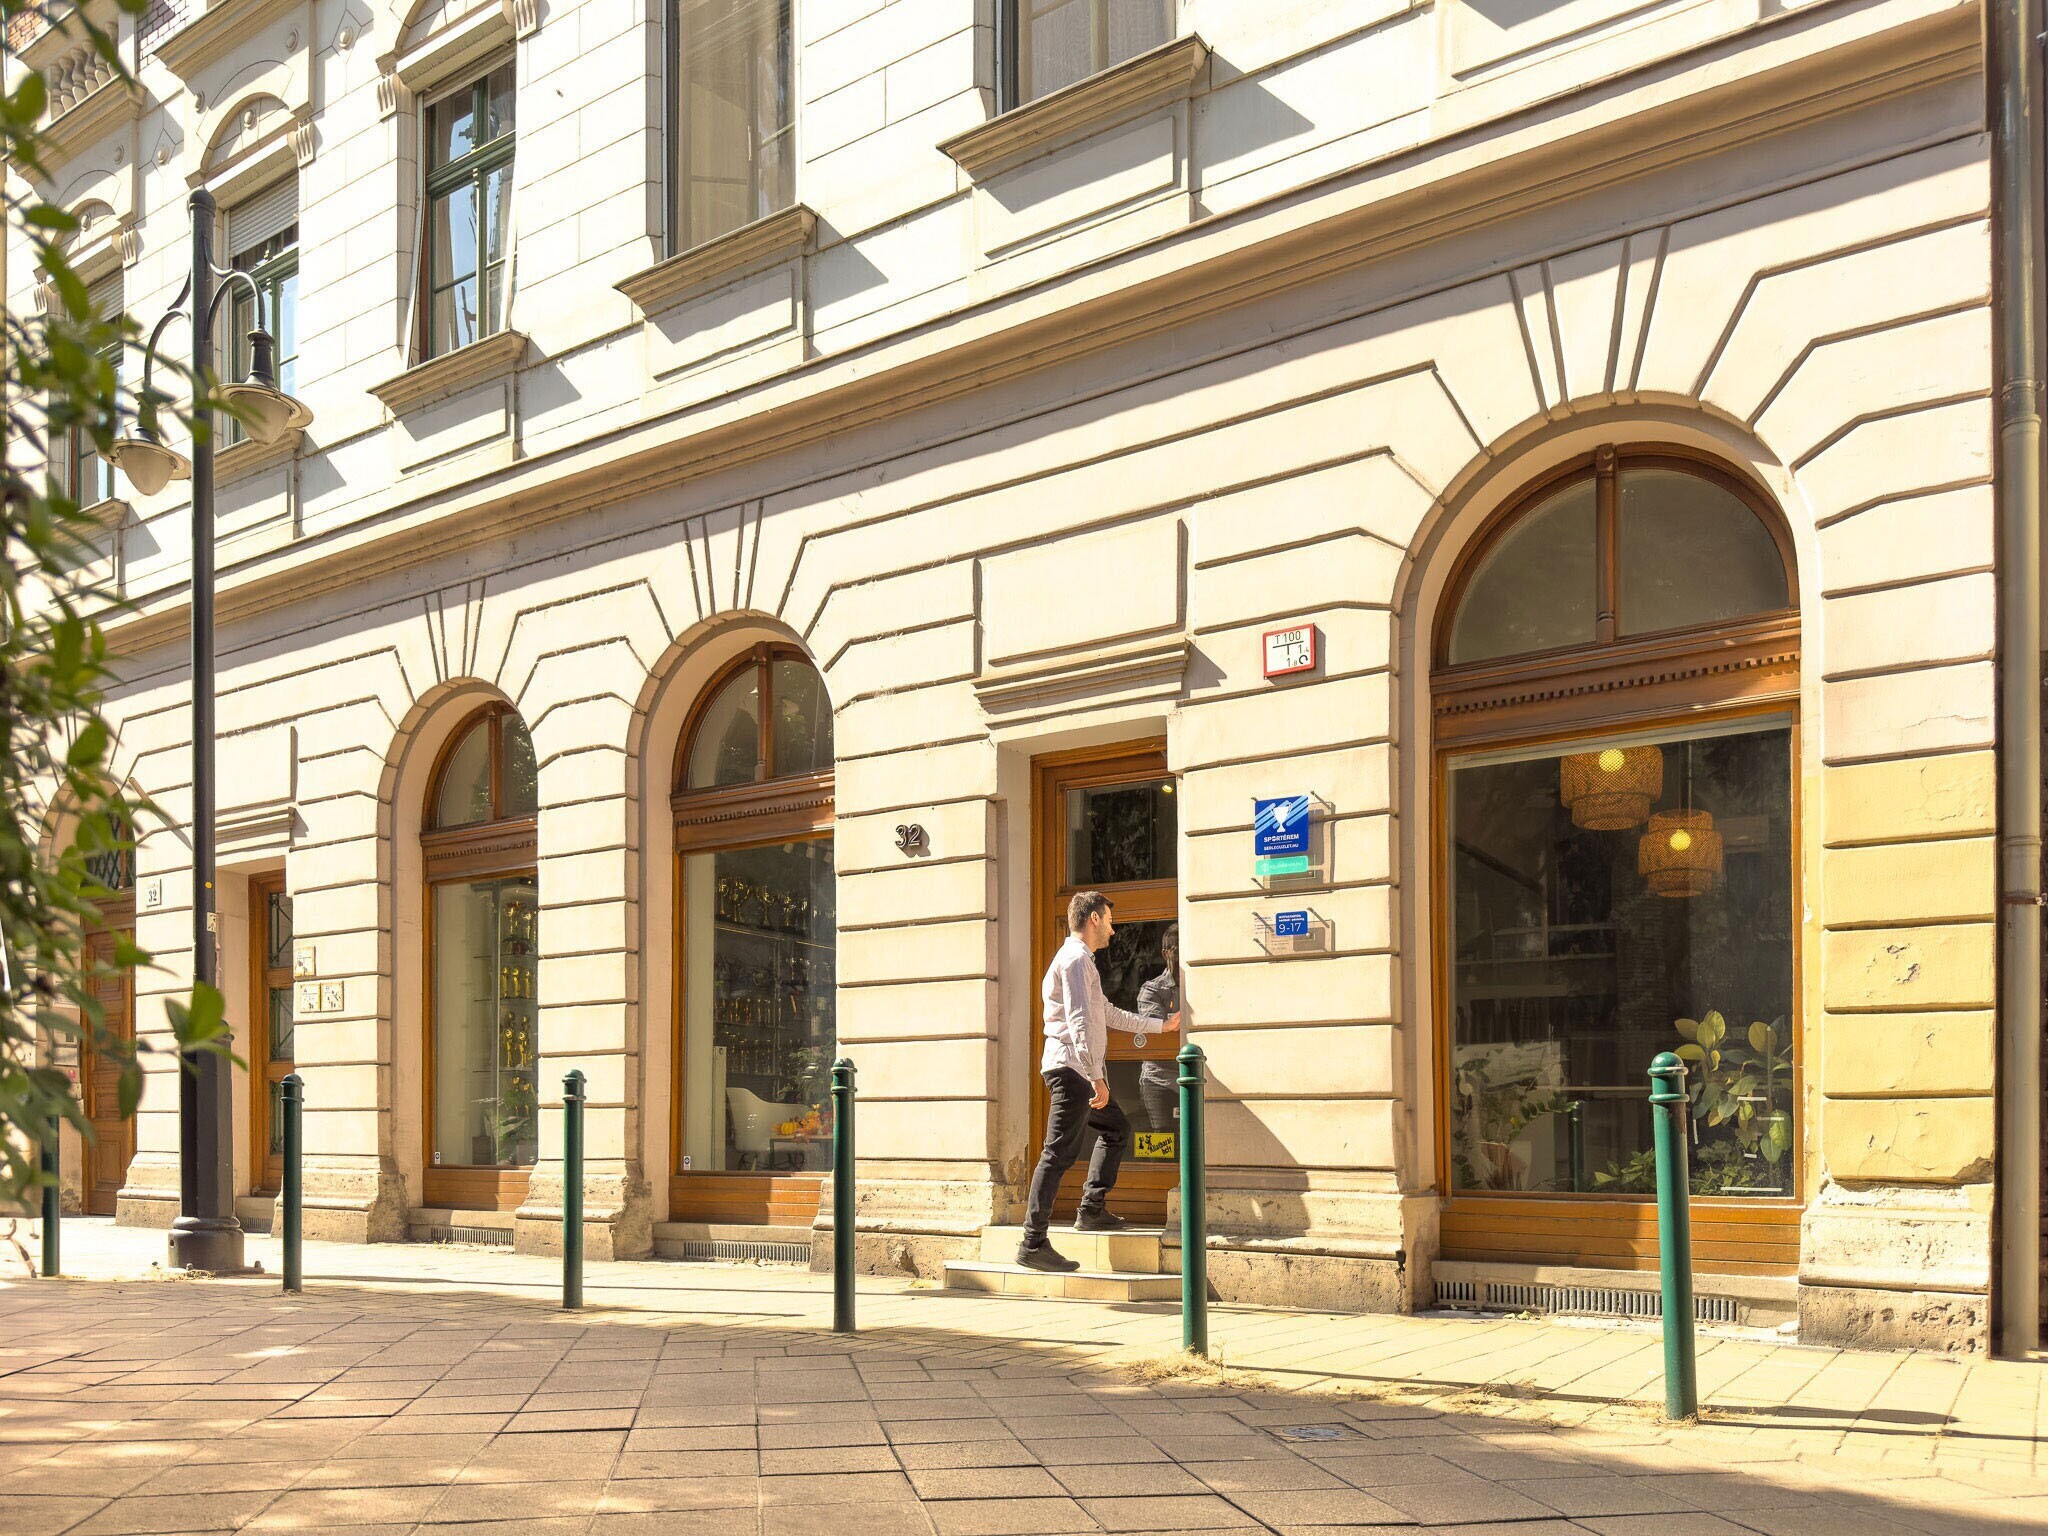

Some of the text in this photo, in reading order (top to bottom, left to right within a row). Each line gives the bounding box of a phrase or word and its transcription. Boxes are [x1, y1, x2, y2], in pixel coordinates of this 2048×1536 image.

[895, 823, 921, 848] 32
[148, 889, 158, 902] 32
[1278, 922, 1302, 933] 9-17
